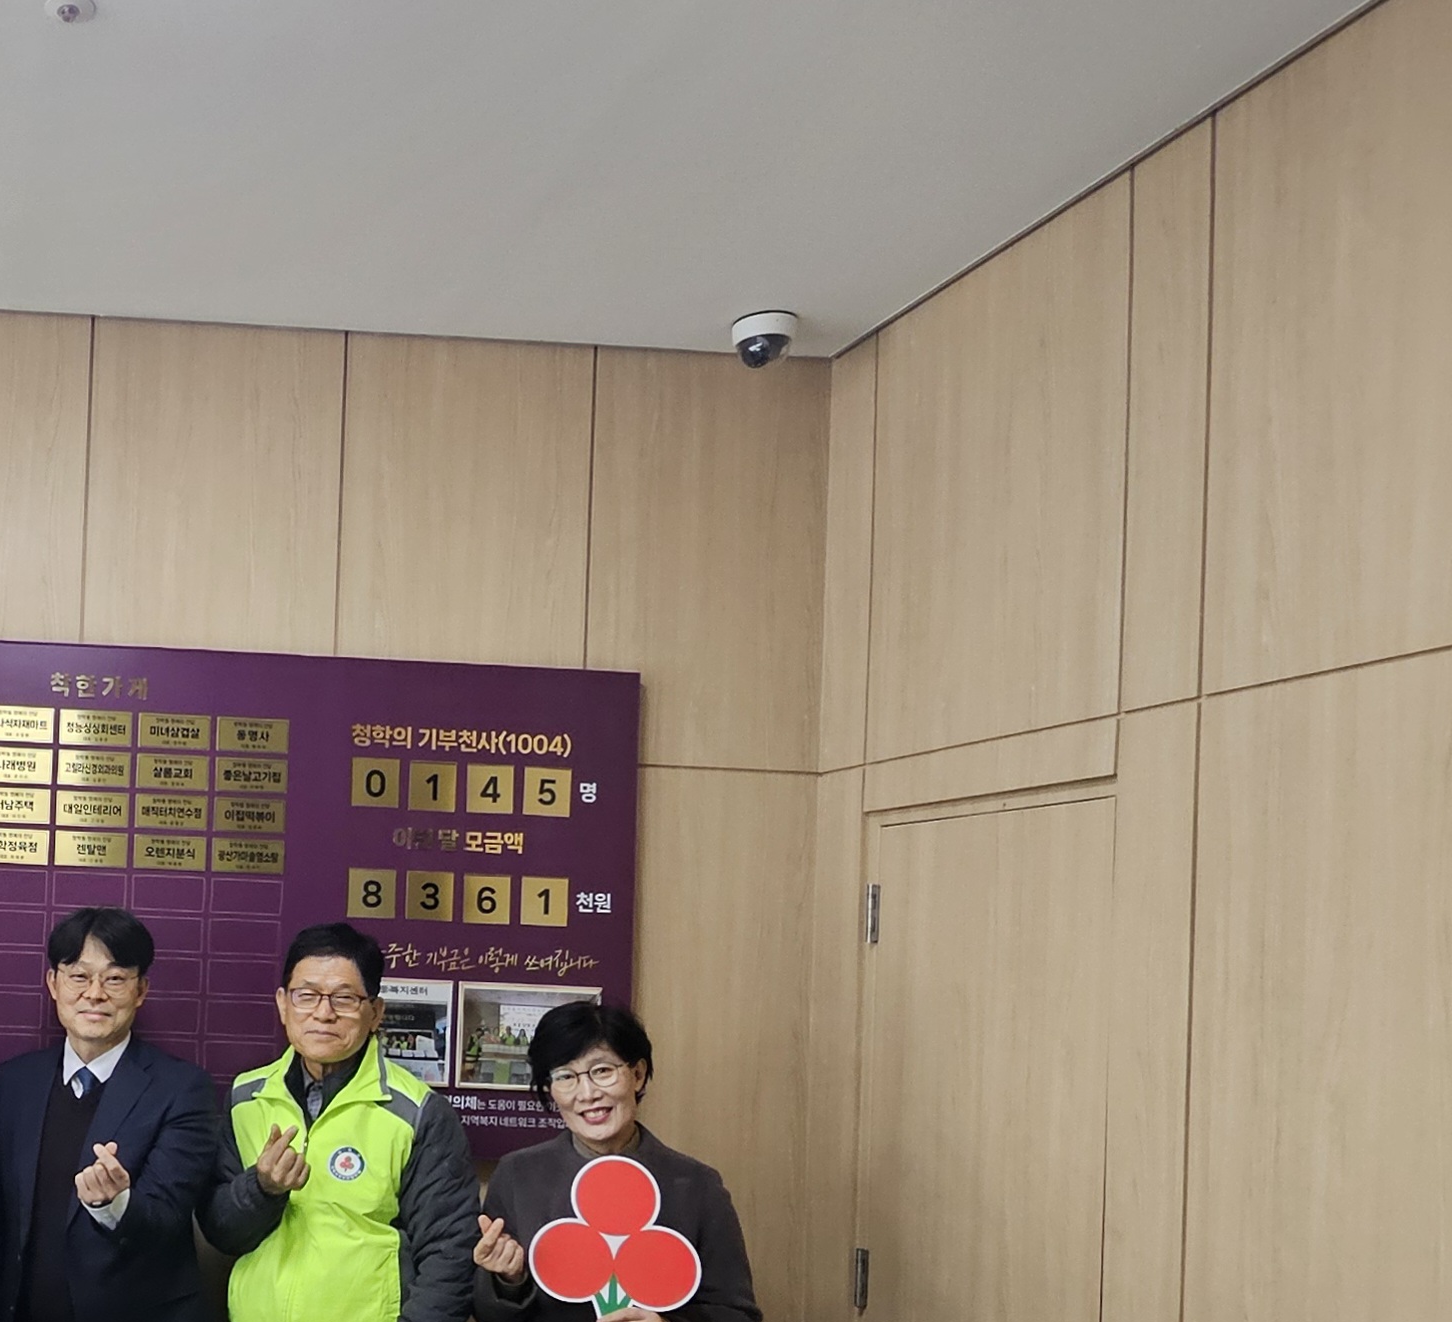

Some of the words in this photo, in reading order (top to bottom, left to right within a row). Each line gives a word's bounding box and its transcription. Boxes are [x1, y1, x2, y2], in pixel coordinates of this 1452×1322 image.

[50, 671, 148, 700] 착한가게
[150, 726, 200, 739] 미녀삼겹살
[237, 729, 270, 742] 동명사
[352, 724, 412, 749] 청학의
[418, 728, 572, 758] 기부천사(1004)
[579, 782, 597, 803] 명
[63, 803, 122, 817] 대일인테리어
[76, 843, 107, 856] 렌탈맨
[464, 832, 524, 854] 모금액
[145, 846, 195, 860] 오렌지분식
[576, 892, 612, 914] 천원
[488, 1100, 515, 1111] 도움이
[461, 1116, 497, 1126] 지역복지
[499, 1116, 536, 1127] 네트워크
